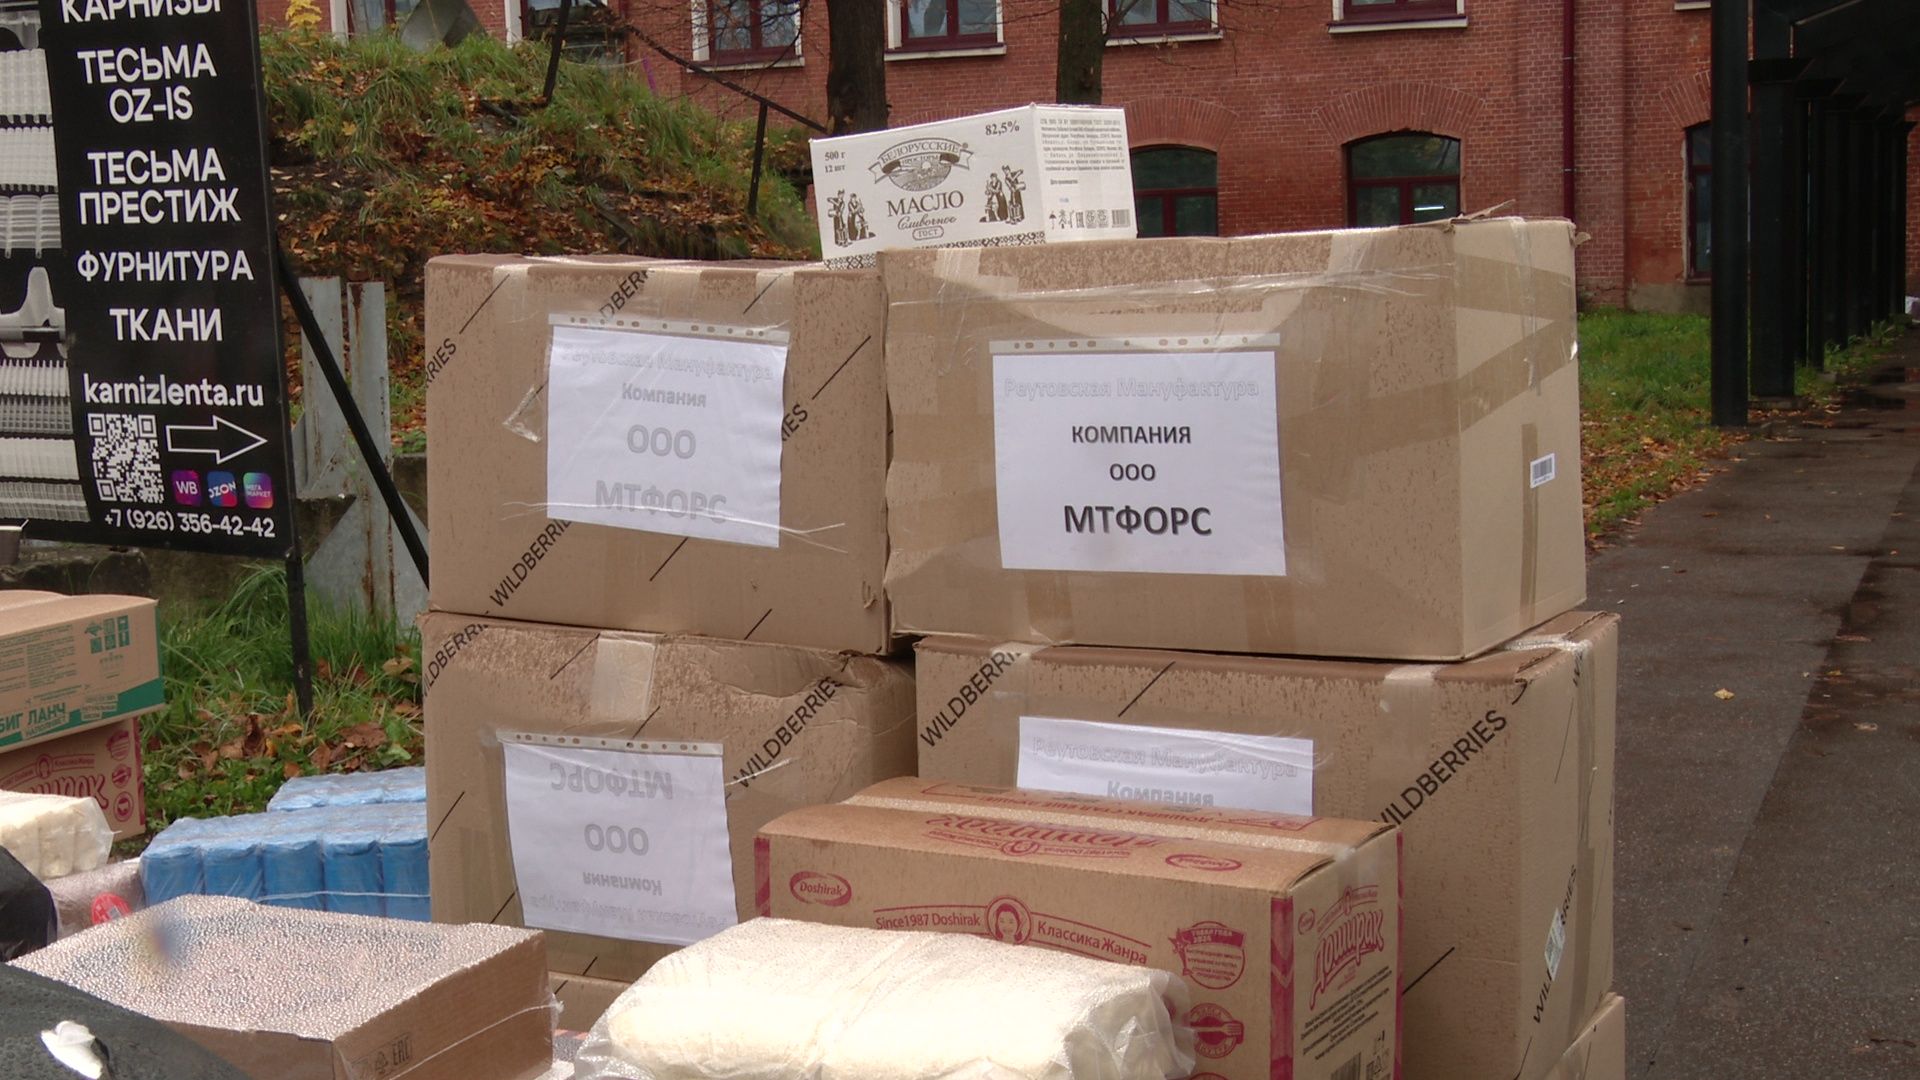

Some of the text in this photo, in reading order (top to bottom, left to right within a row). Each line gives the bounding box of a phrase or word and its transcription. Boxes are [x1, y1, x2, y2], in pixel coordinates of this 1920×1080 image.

[77, 43, 217, 84] ТЕСЬМА
[109, 86, 193, 123] OZ-IS
[985, 120, 1020, 136] 82,5%
[87, 148, 226, 185] ТЕСЬМА
[824, 151, 839, 161] 500
[880, 141, 960, 164] БЕЛОРУССКИЕ
[825, 165, 833, 173] 12
[80, 188, 241, 225] ПРЕСТИЖ
[886, 190, 964, 217] МАСЛО
[897, 215, 957, 230] Сливочное
[918, 229, 939, 237] ГОСТ
[77, 250, 254, 282] ФУРНИТУРА
[109, 308, 223, 341] ТКАНИ
[83, 373, 264, 407] karnizlenta.ru
[622, 383, 706, 407] Компания
[1004, 378, 1260, 401] Реутовская Мануфактура
[627, 425, 696, 458] ООО
[1072, 426, 1191, 444] КОМПАНИЯ
[1109, 463, 1155, 481] ООО
[175, 481, 198, 495] WB
[595, 480, 726, 523] МТФОРС
[105, 509, 276, 538] +7 (926) 356-42-42
[1064, 505, 1212, 535] МТФОРС
[920, 652, 1021, 747] WILDBERRI
[0, 712, 23, 733] БИГ
[28, 703, 65, 725] ЛАНЧ
[1033, 736, 1298, 780] Реутовская Мануфактура
[550, 763, 674, 800] МТФОРС
[1107, 781, 1214, 807] Компания
[584, 824, 649, 856] ООО
[583, 871, 663, 896] Компания
[800, 882, 843, 896] Doshirak
[932, 913, 980, 927] Doshirak
[1038, 920, 1147, 964] Классика Жанра
